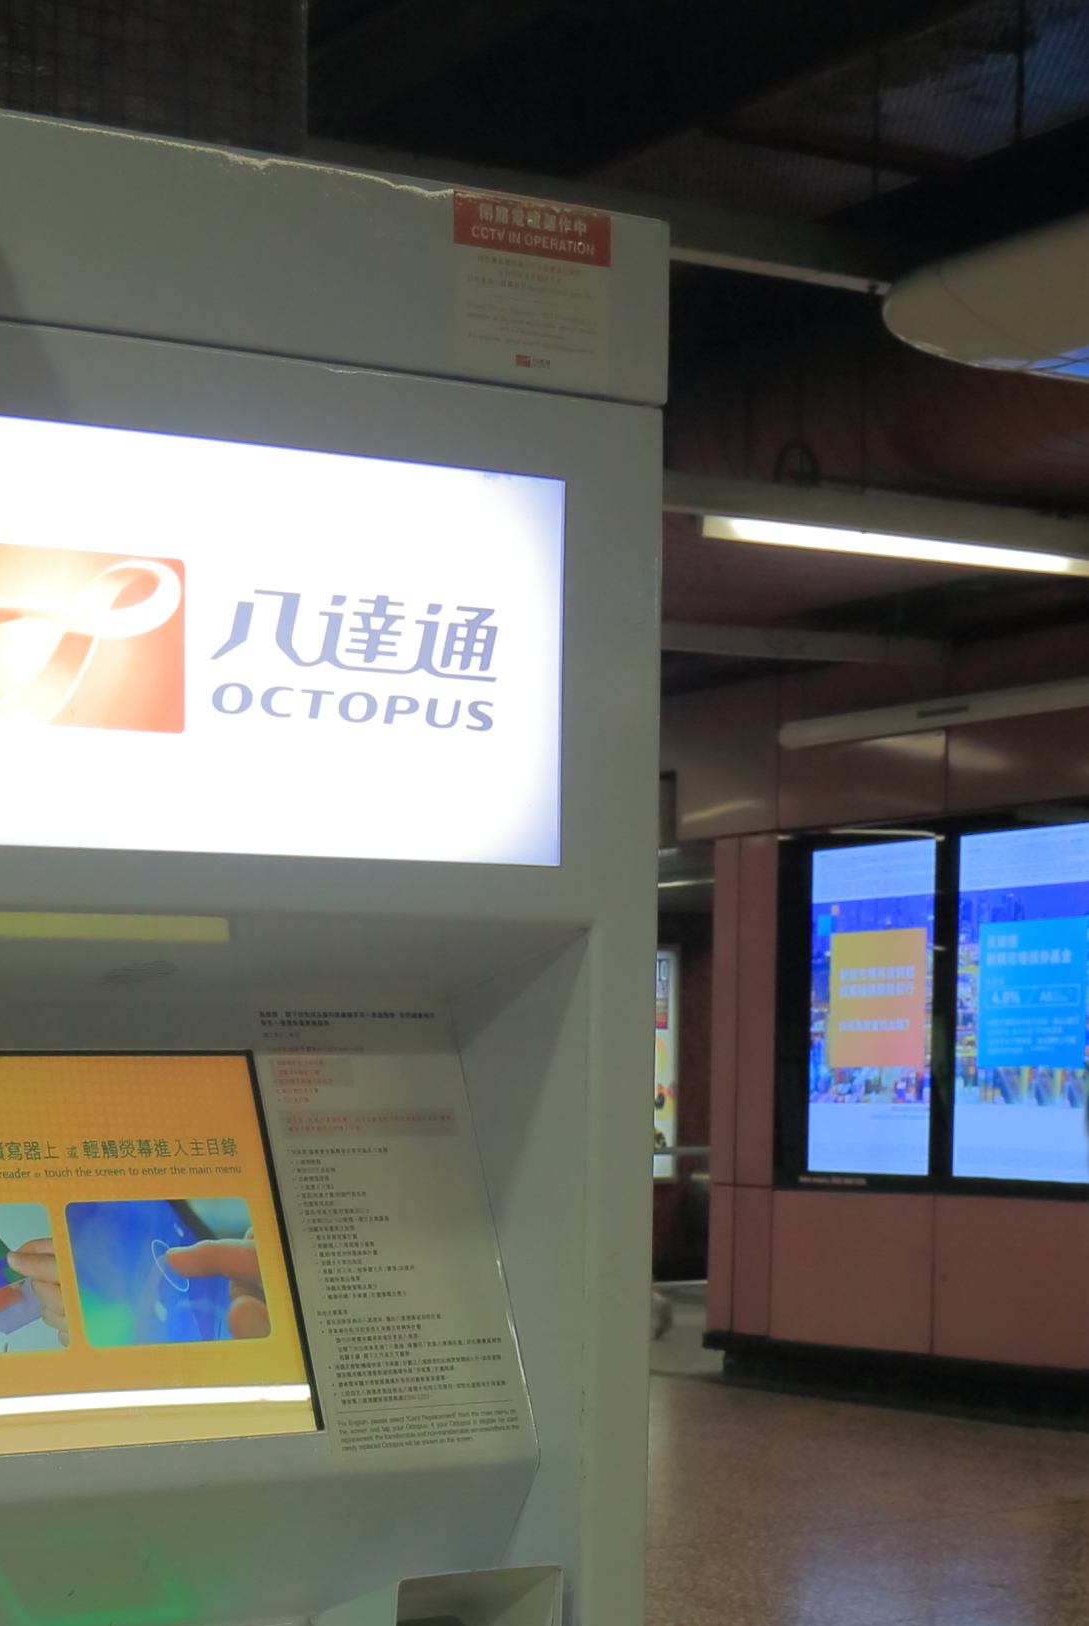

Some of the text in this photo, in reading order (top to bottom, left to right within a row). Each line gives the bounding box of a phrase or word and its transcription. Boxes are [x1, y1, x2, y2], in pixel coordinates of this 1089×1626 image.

[471, 225, 595, 256] CCTV IN OPERATION
[210, 588, 499, 683] 八達通
[210, 681, 495, 733] OCTOPUS
[66, 1146, 79, 1160] 或
[44, 1168, 73, 1179] touch
[76, 1167, 92, 1178] the
[95, 1168, 126, 1177] screen
[129, 1167, 139, 1176] to
[142, 1166, 167, 1175] enter
[170, 1165, 187, 1175] the
[189, 1164, 213, 1175] main
[215, 1166, 242, 1175] menu
